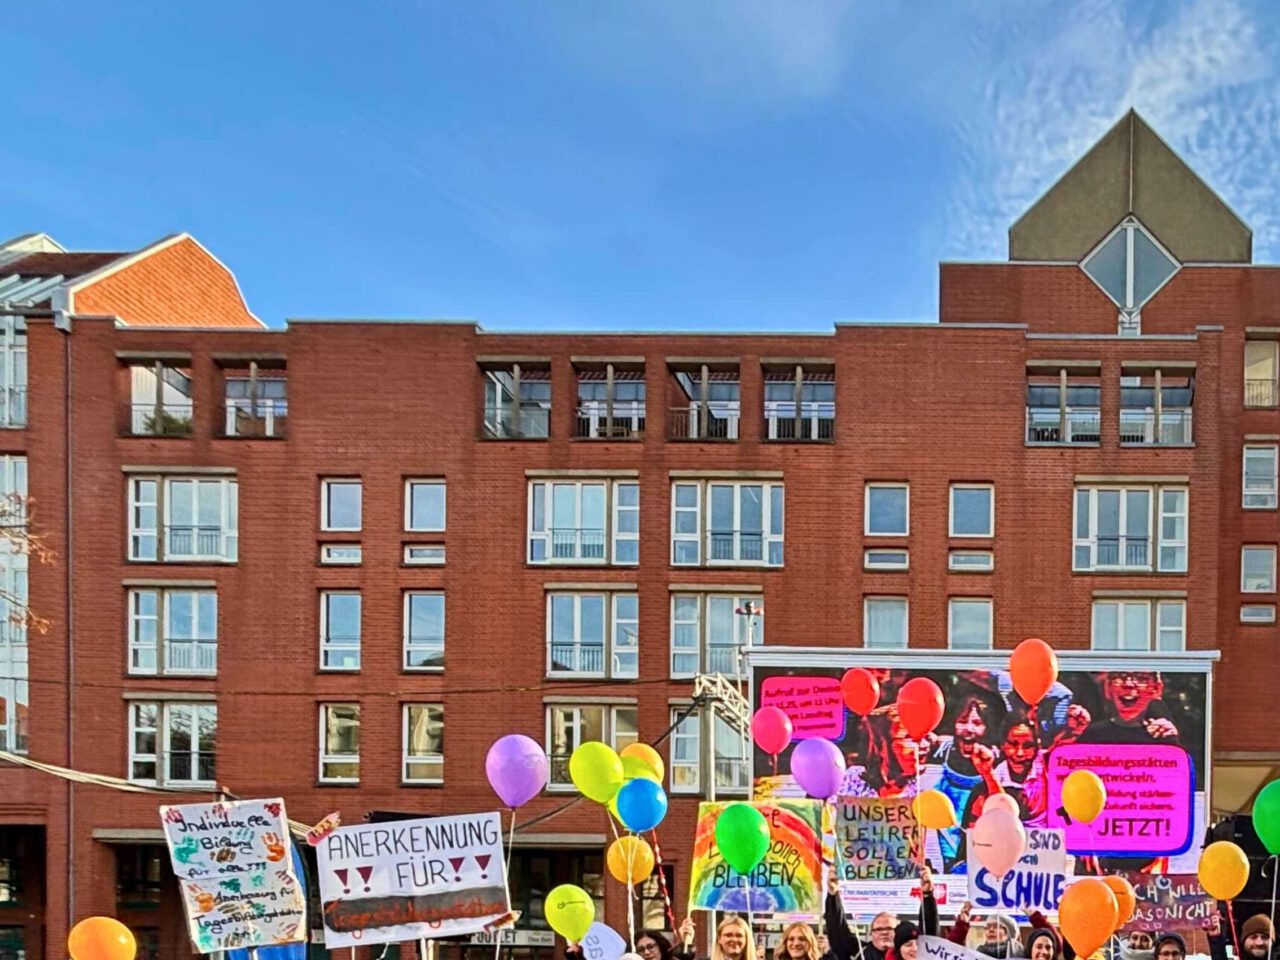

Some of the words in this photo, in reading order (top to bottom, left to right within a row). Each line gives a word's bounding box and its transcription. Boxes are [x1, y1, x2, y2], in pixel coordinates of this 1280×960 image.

[1056, 756, 1177, 769] Tagesbildungsstätten
[1098, 818, 1171, 836] JETZT!
[328, 819, 498, 861] ANERKENNUNG
[1030, 829, 1061, 851] SIND
[843, 844, 919, 860] SOLLEN
[396, 855, 449, 888] FÜR
[976, 867, 1065, 910] SCHULE
[1165, 901, 1214, 919] NICHT
[925, 941, 952, 960] Wir
